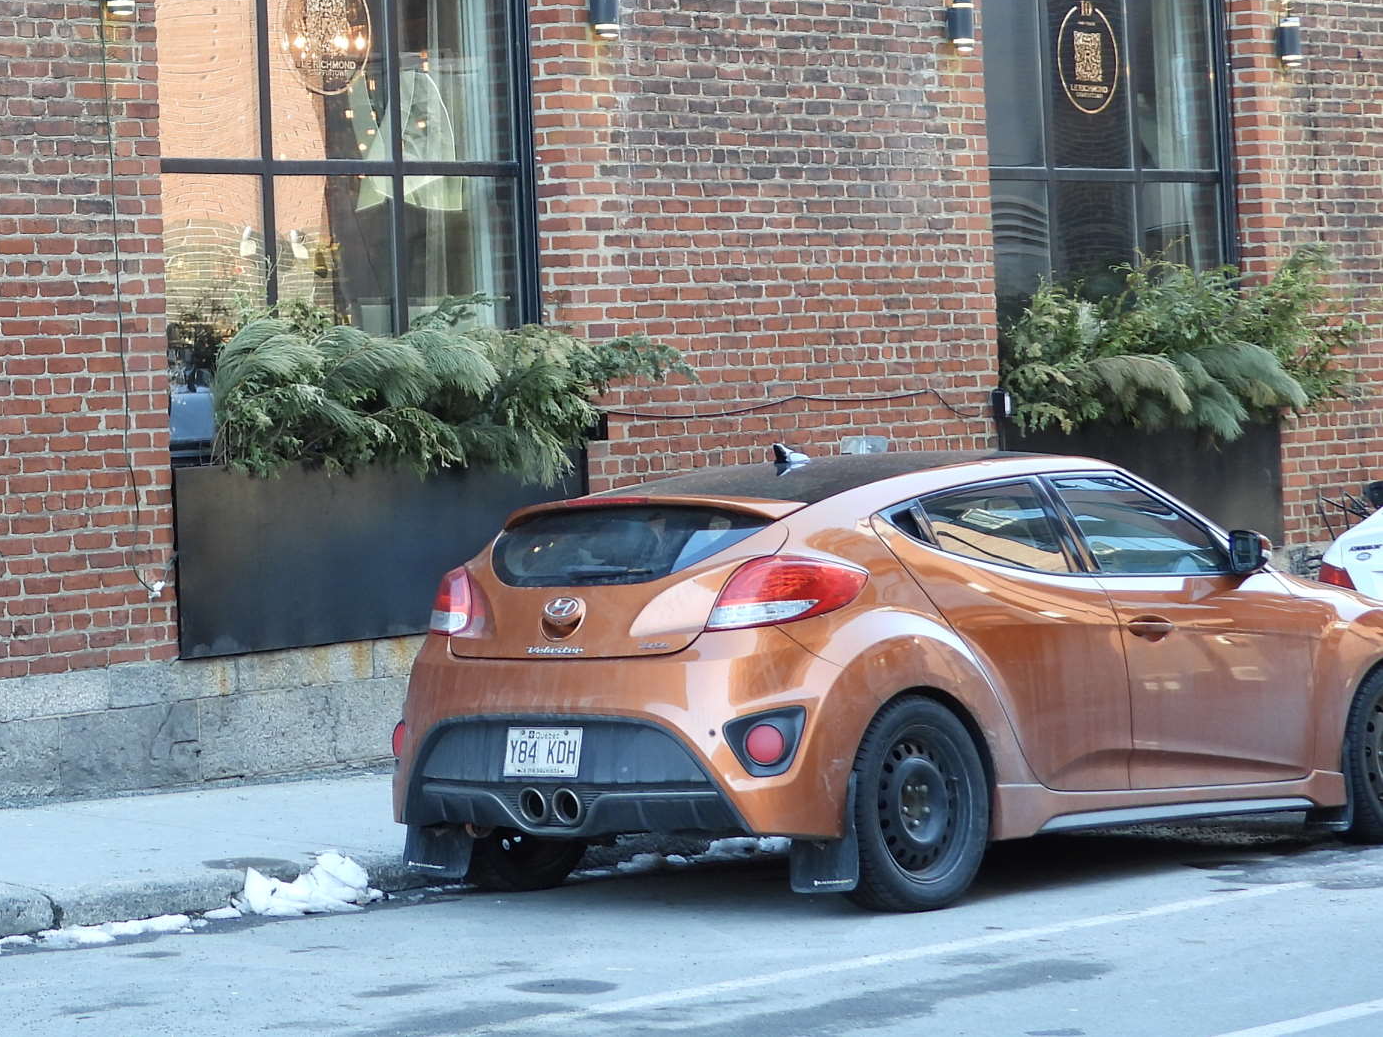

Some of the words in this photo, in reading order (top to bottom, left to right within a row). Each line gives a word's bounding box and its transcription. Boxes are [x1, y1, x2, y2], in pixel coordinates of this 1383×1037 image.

[314, 60, 356, 70] RICHMOND
[510, 740, 537, 764] Y84
[546, 740, 577, 764] KDH
